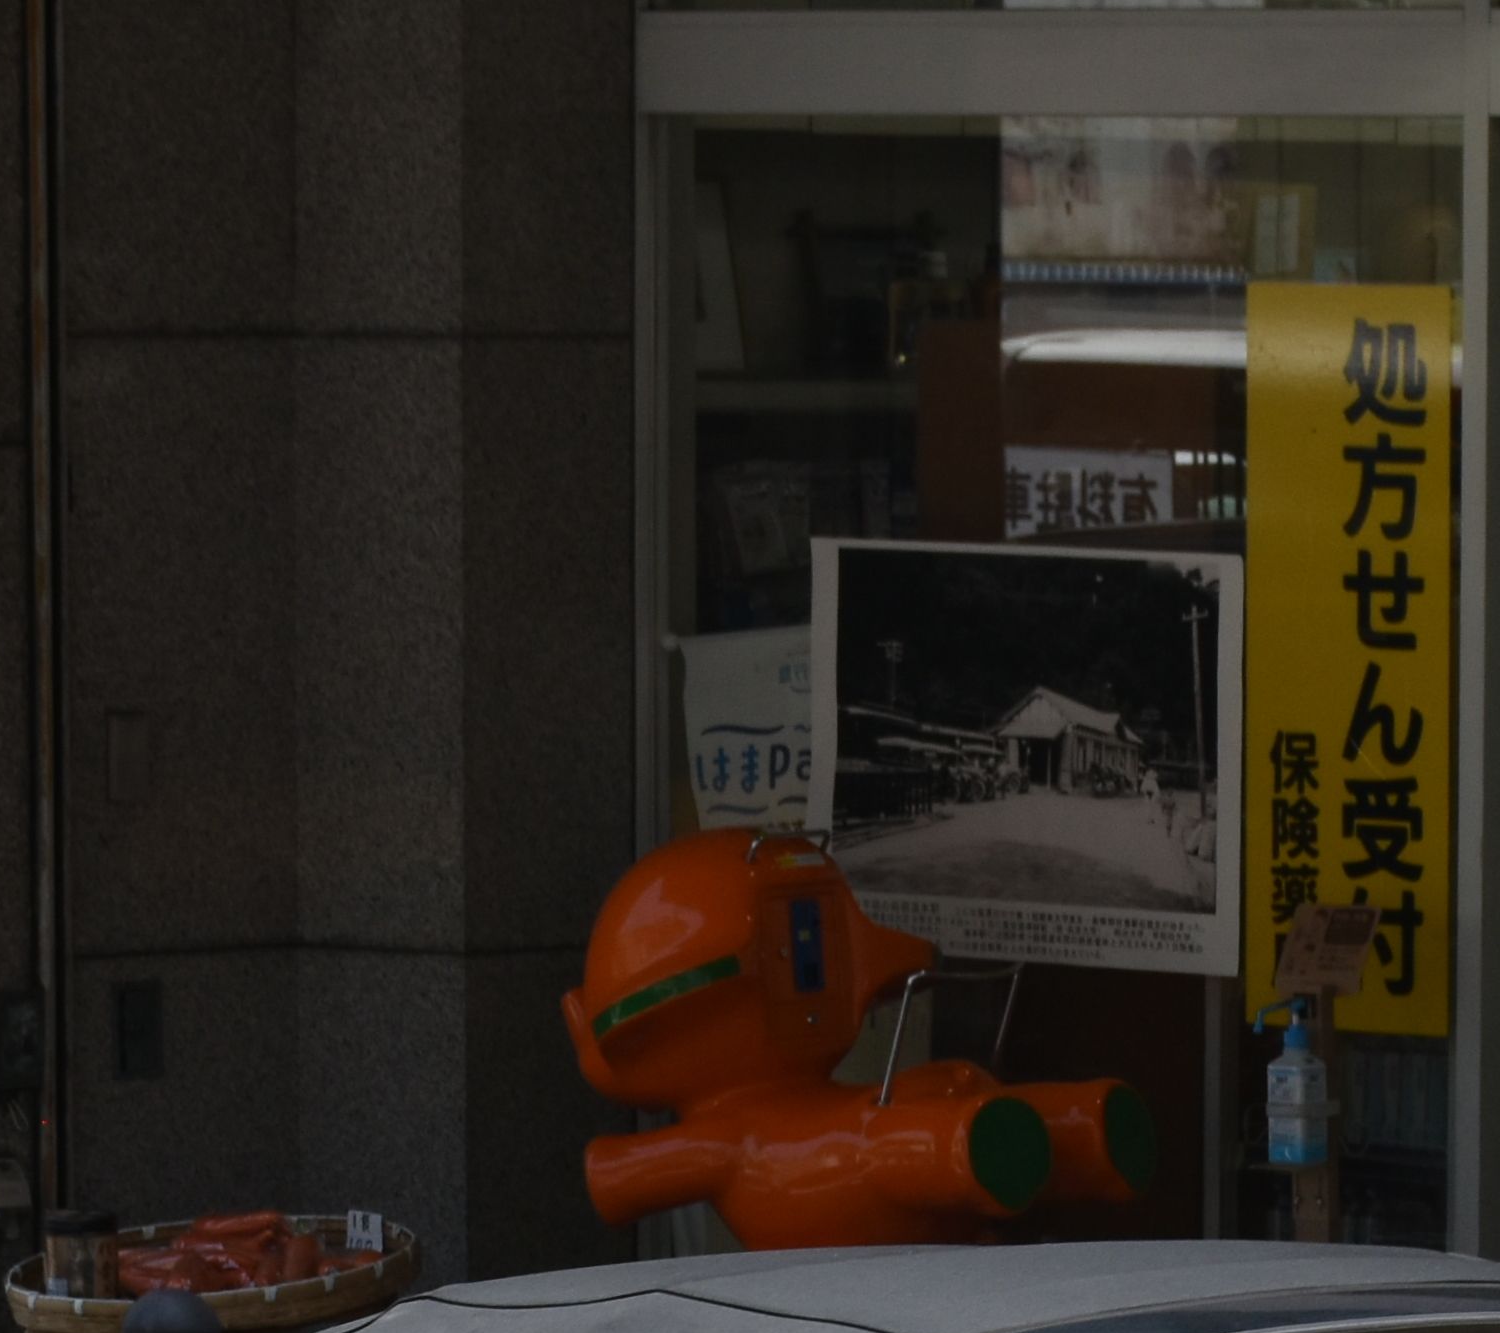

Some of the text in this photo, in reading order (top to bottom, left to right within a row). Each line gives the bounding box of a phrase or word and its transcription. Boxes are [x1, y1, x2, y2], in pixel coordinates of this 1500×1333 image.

[1268, 730, 1321, 988] 保険薬
[1340, 316, 1428, 998] 処方せん受付
